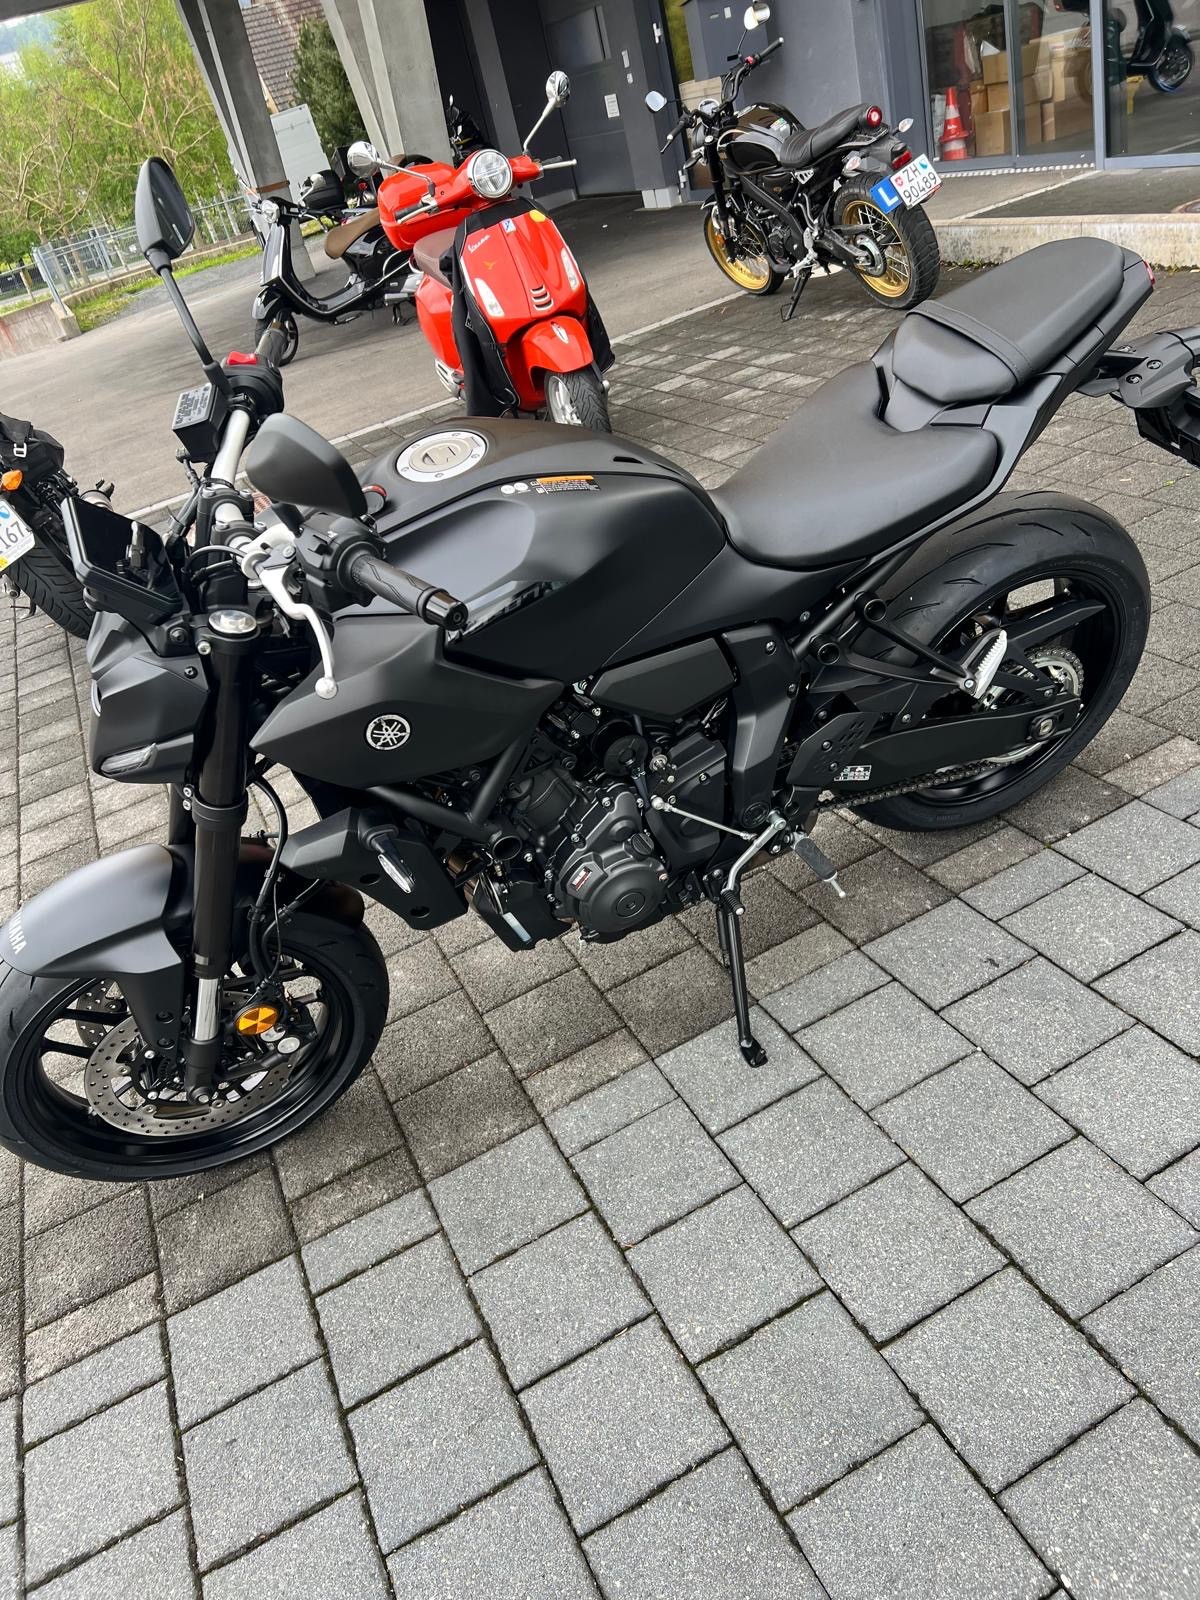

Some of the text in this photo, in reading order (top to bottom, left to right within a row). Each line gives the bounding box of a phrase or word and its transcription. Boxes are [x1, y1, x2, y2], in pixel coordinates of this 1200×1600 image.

[903, 163, 921, 183] ZH
[877, 187, 899, 207] L
[903, 172, 937, 203] 90489
[0, 520, 25, 552] 167
